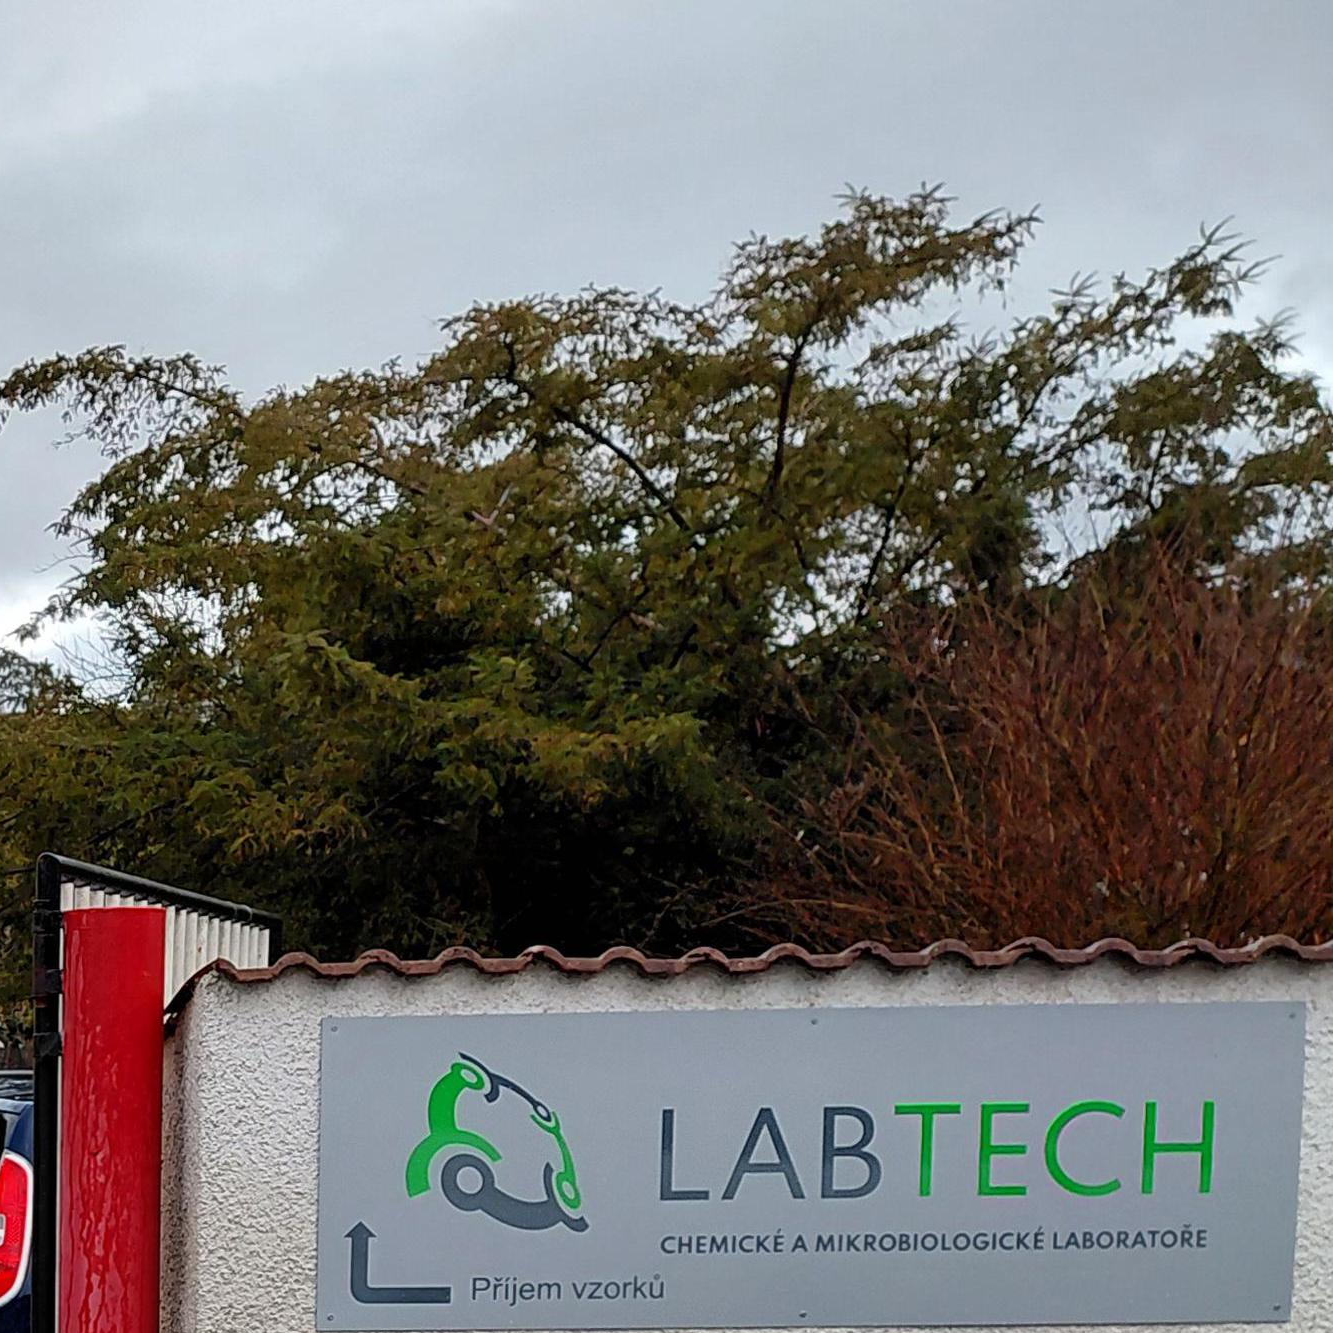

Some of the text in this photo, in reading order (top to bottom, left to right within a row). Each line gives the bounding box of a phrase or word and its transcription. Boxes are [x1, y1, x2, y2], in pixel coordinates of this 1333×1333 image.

[659, 1100, 1215, 1201] LABTECH
[659, 1223, 1209, 1255] CHEMICKÉ A MIKROBIOLOGICKÉ LABORATOŘE
[470, 1273, 666, 1307] Příjem vzorků
